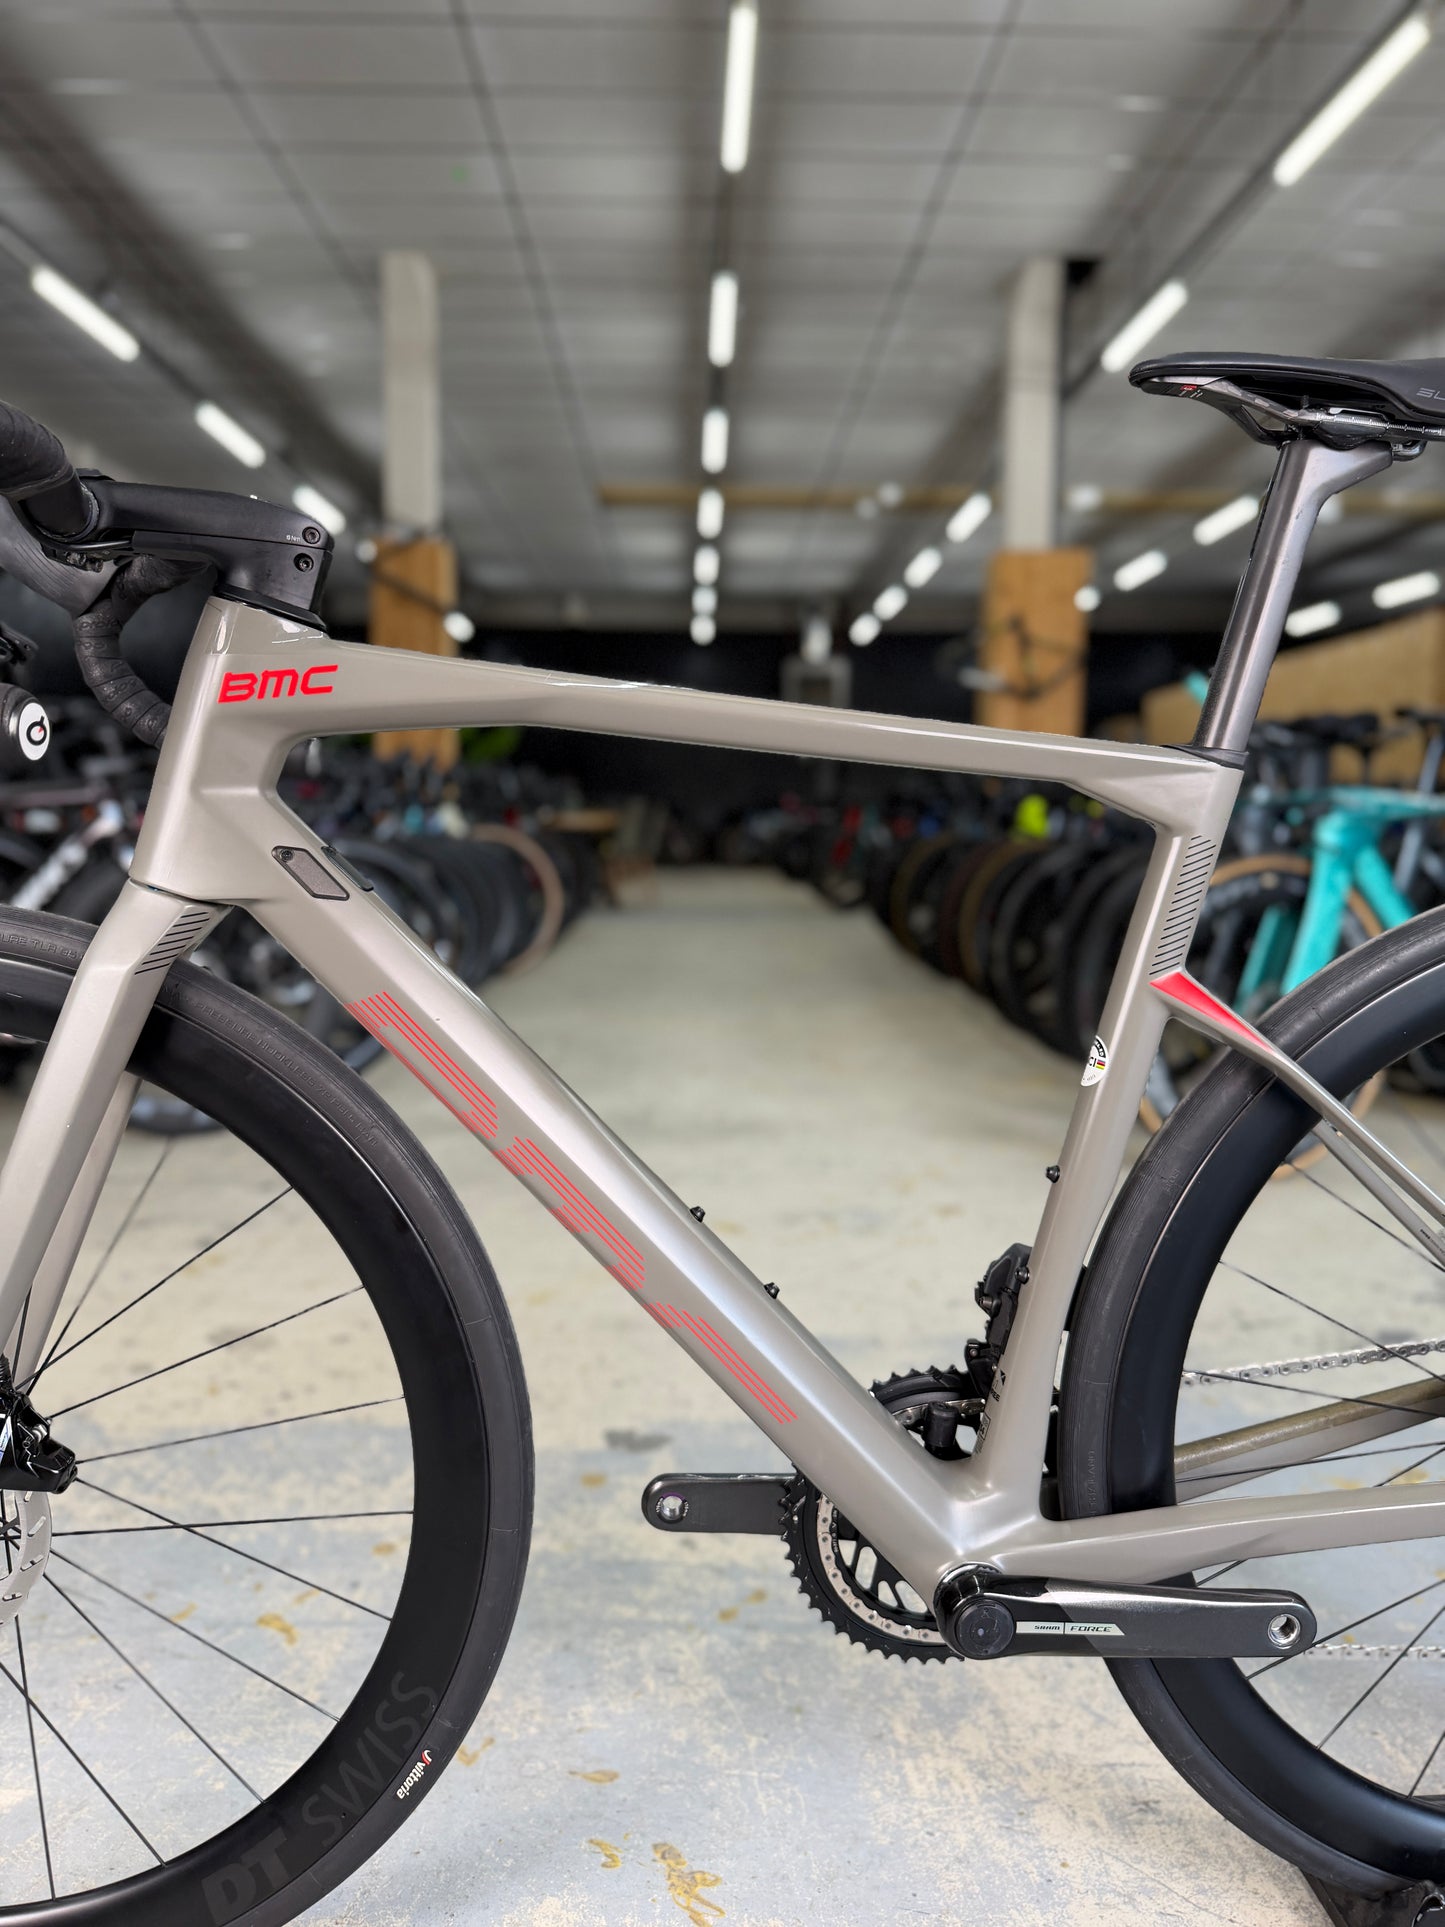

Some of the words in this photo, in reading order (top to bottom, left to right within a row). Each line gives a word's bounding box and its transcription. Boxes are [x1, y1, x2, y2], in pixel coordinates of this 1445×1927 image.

[217, 664, 338, 704] BMC
[1070, 1625, 1113, 1633] FORCE
[200, 1826, 288, 1926] DT
[300, 1672, 438, 1848] SWISS
[396, 1759, 429, 1800] vittoria
